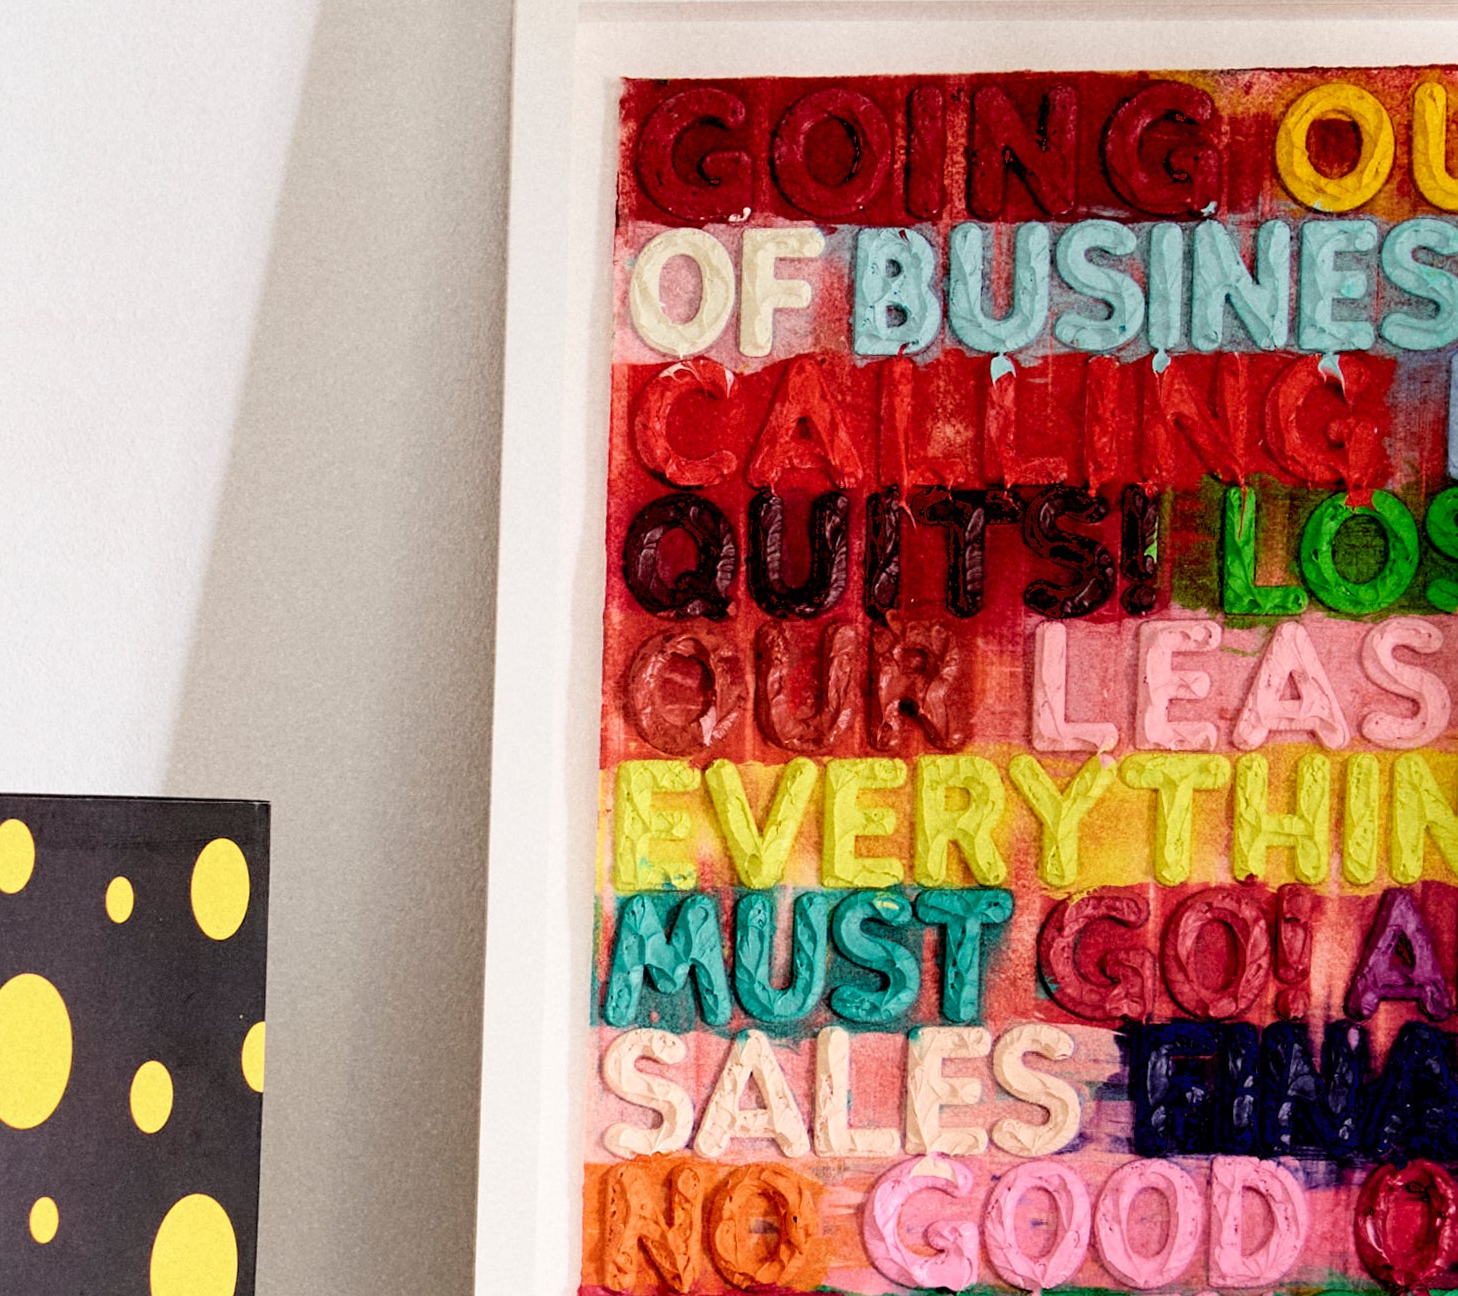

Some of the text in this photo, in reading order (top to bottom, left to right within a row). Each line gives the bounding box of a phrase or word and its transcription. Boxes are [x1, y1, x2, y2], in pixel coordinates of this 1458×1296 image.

[635, 80, 1219, 220] GOING
[629, 226, 826, 358] OF
[633, 353, 1385, 490] CALLING
[622, 484, 1161, 619] QUITS!
[624, 619, 966, 755] OUR
[601, 887, 1014, 1026] MUST
[1037, 883, 1314, 1020] GO!
[599, 1022, 1084, 1160] SALES
[601, 1160, 818, 1295] NO
[861, 1154, 1309, 1292] GOOD
